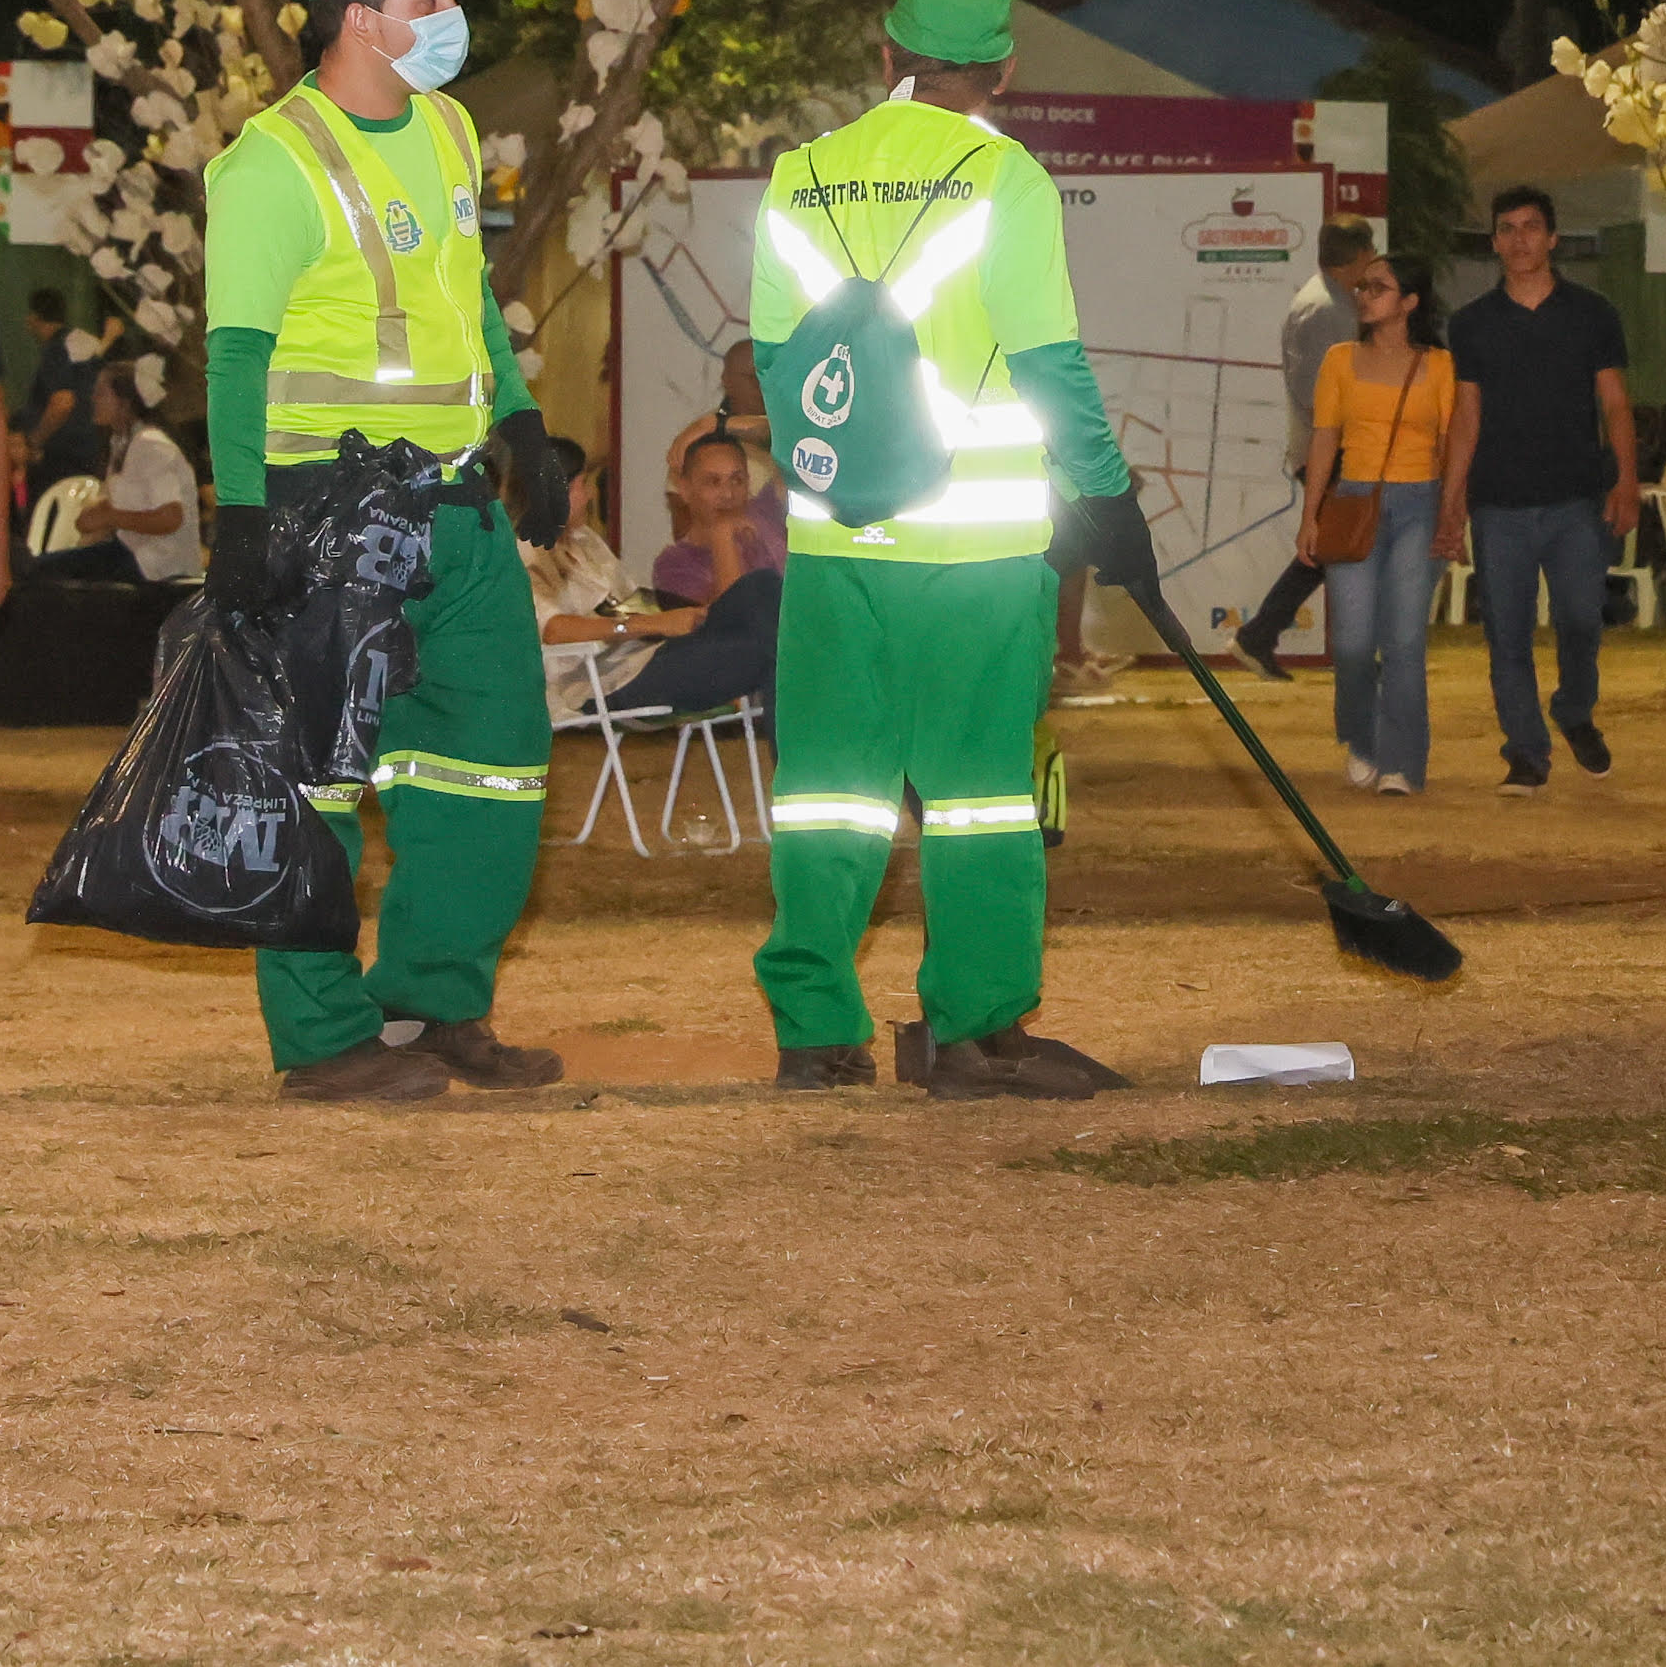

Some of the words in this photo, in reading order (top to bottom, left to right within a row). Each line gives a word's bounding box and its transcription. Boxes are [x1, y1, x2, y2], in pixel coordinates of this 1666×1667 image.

[1048, 108, 1095, 122] DOCE
[453, 198, 474, 220] MB
[795, 447, 834, 476] MB
